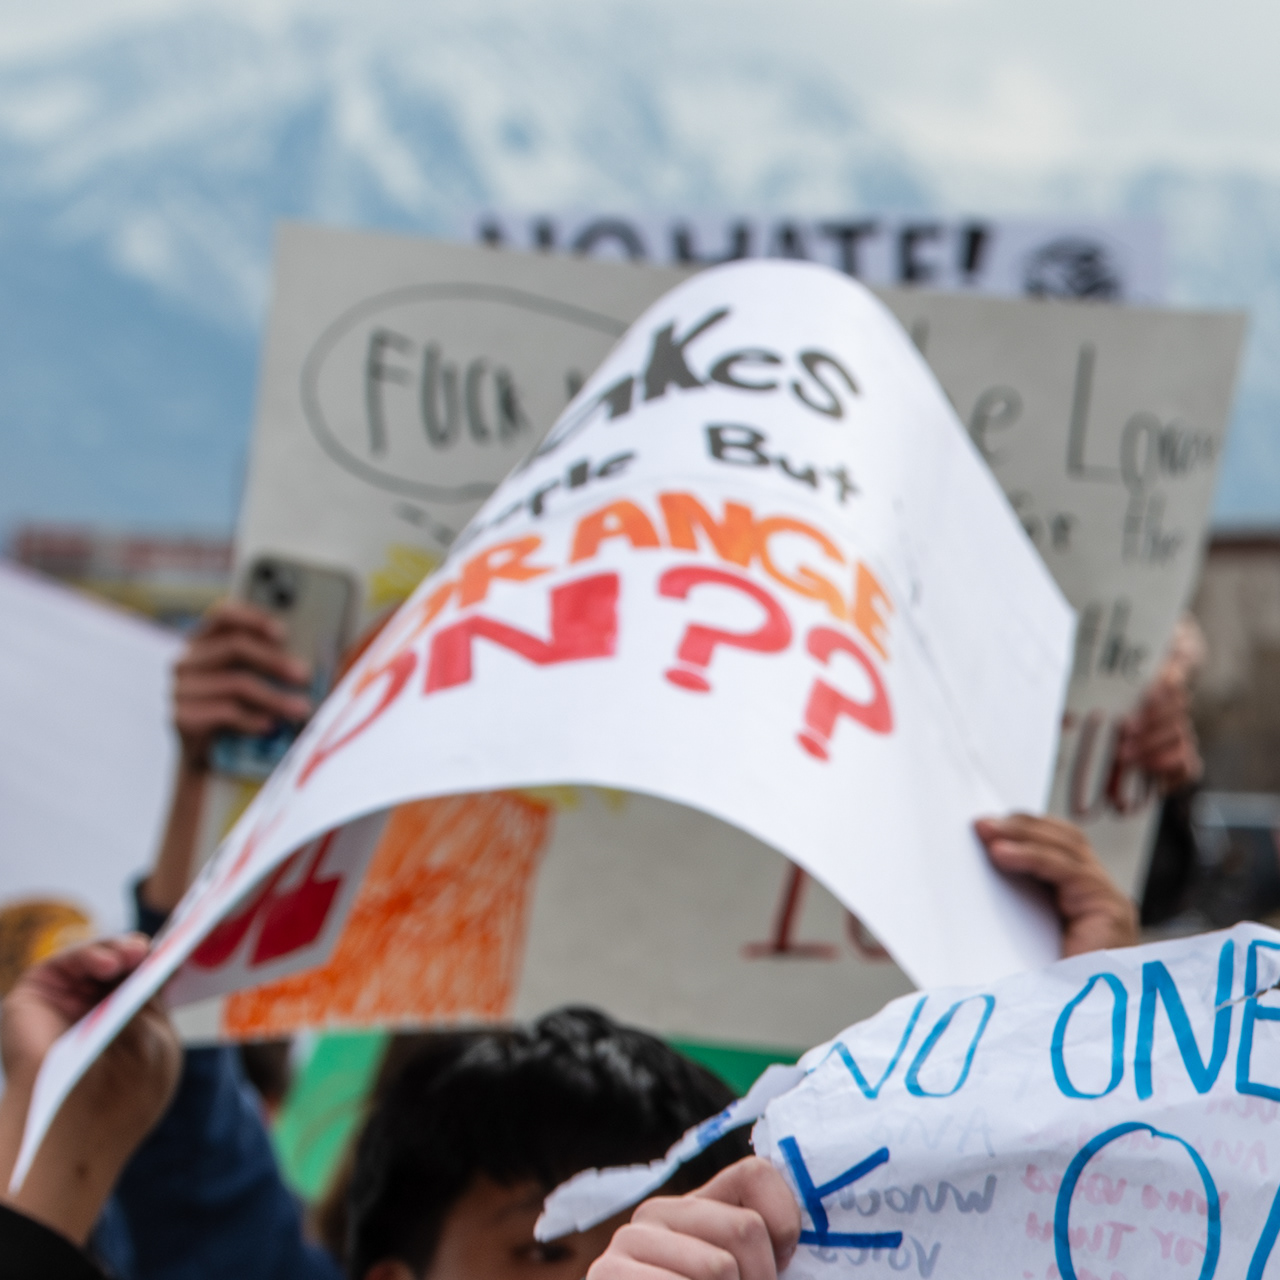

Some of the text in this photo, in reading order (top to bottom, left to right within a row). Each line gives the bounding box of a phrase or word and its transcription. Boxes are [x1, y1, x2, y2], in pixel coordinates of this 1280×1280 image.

[703, 422, 858, 506] But
[345, 490, 893, 705] ORANGE
[804, 994, 996, 1100] NO
